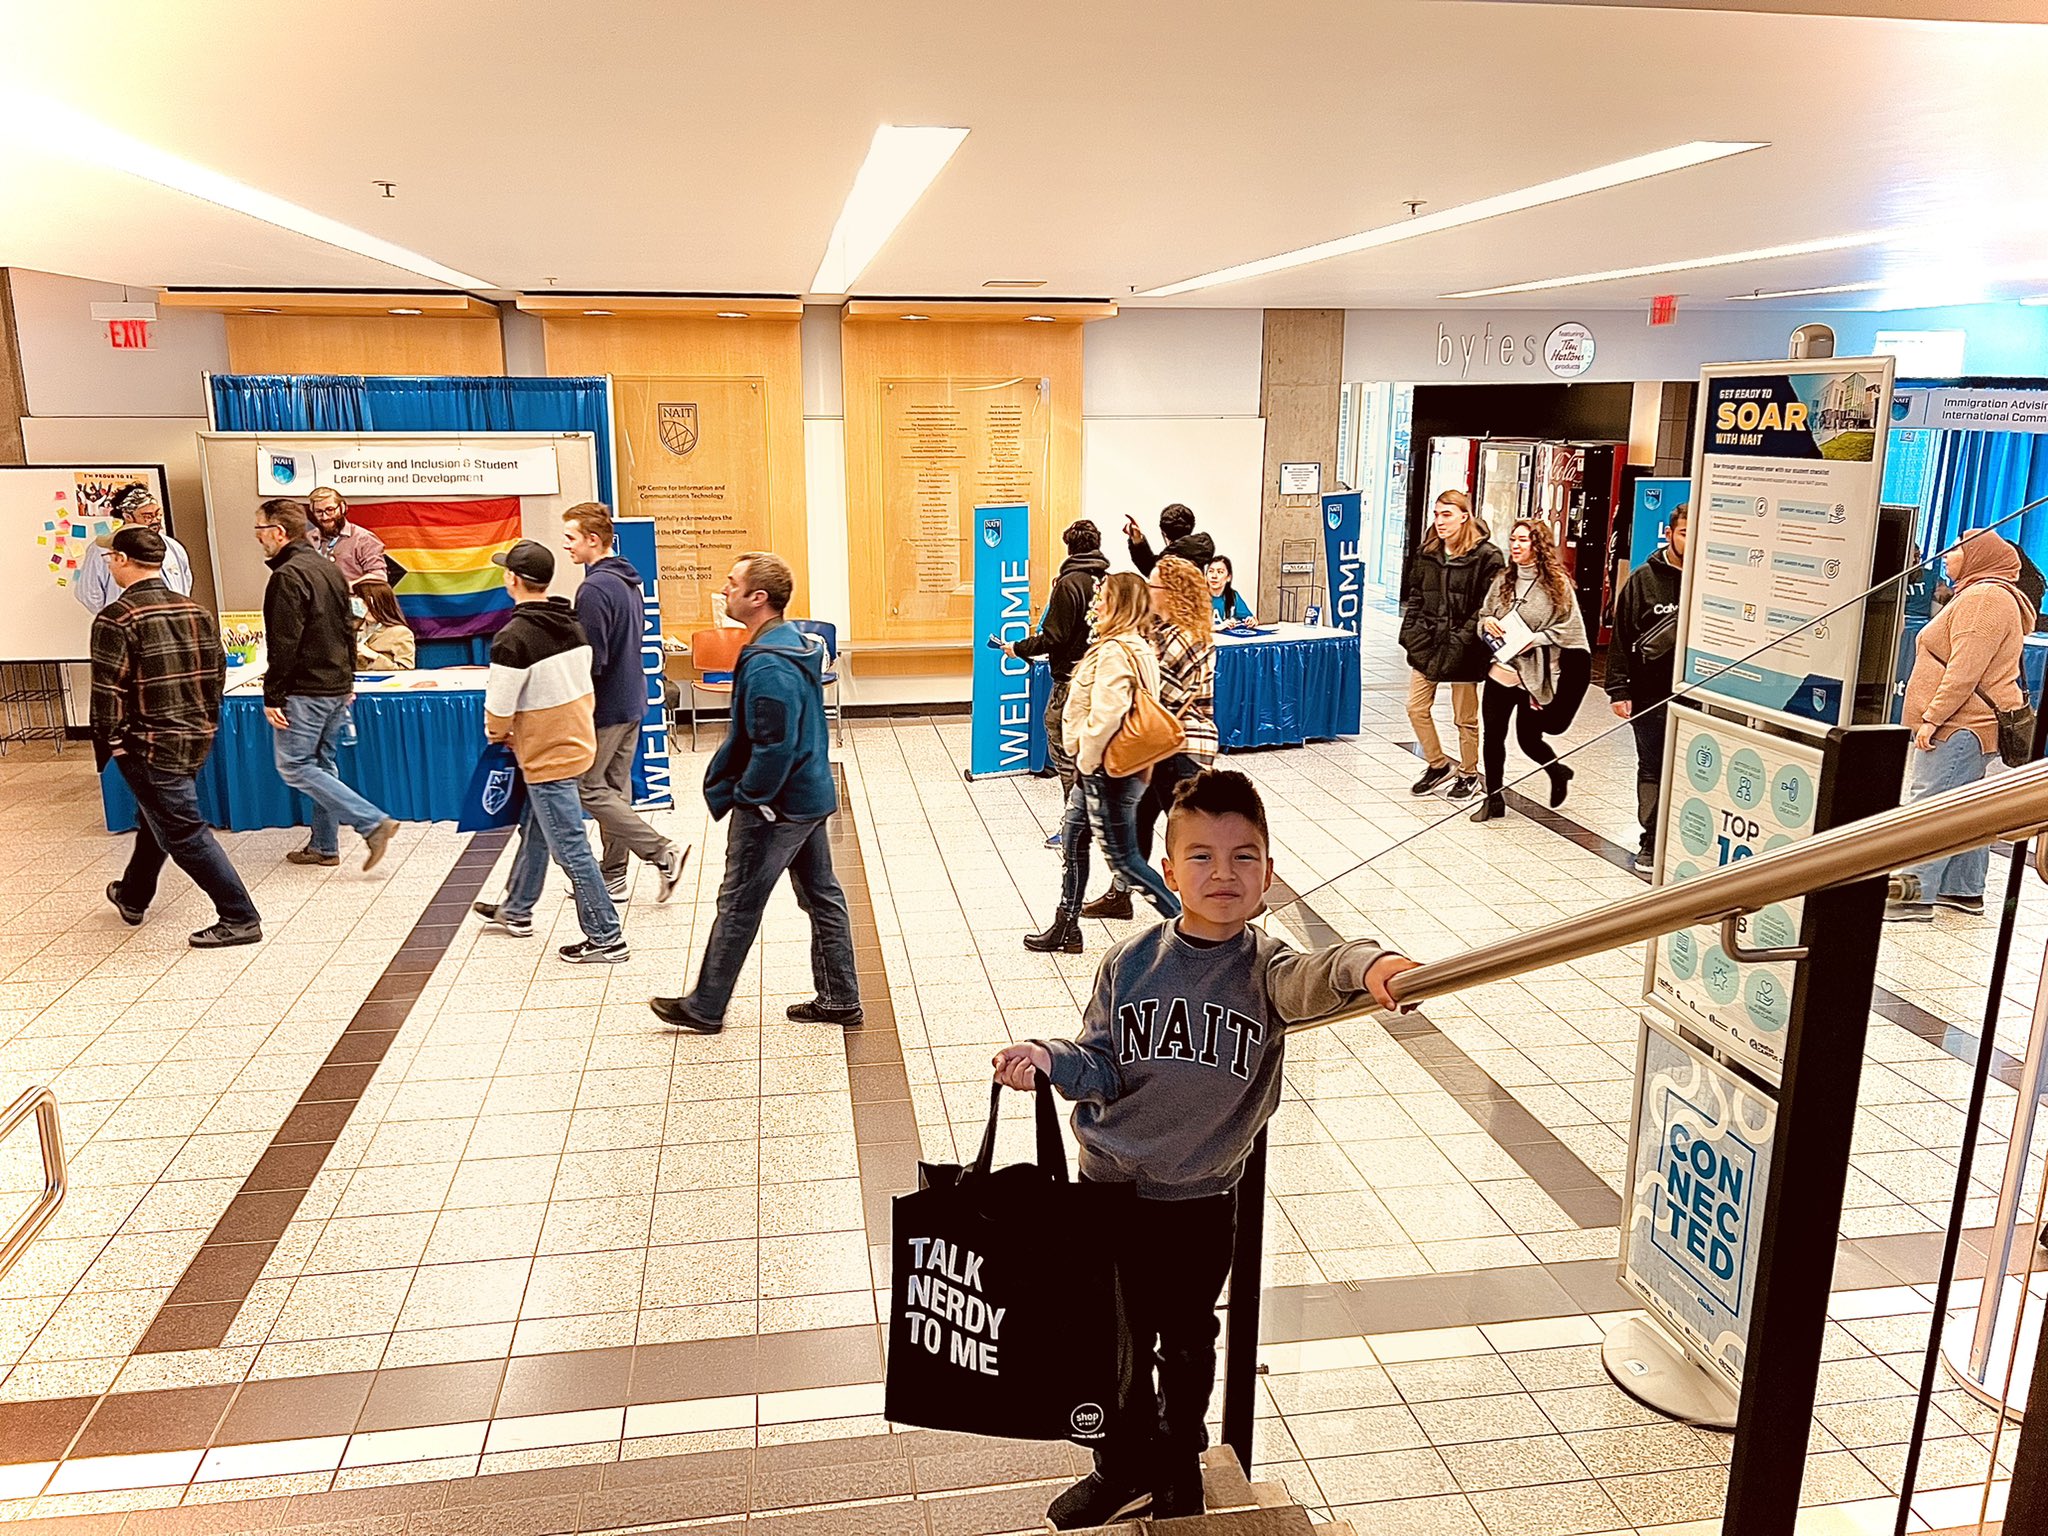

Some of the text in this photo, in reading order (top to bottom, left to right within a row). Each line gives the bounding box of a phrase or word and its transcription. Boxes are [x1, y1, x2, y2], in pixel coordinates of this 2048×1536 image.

[109, 320, 147, 347] EXIT
[1561, 339, 1578, 350] Tim
[1437, 322, 1537, 378] bytes
[1551, 350, 1584, 361] Hortons
[1719, 389, 1772, 399] GET READY TO
[1944, 398, 2008, 410] Immigration
[663, 407, 693, 418] NAIT
[1716, 402, 1808, 431] SOAR
[1942, 411, 2047, 423] International Comm
[1715, 433, 1763, 446] WITH NAIT
[273, 456, 293, 465] NAIT
[333, 459, 383, 470] Diversity
[386, 459, 408, 469] and
[410, 459, 461, 469] Inclusion
[474, 459, 518, 469] Student
[333, 473, 484, 486] Learning and Development
[1000, 560, 1031, 766] WELCOME
[641, 578, 672, 806] WELCOME
[1721, 809, 1760, 842] TOP
[1118, 997, 1264, 1081] NAIT
[1670, 1123, 1744, 1206] CON
[1667, 1159, 1740, 1244] NEC
[1667, 1197, 1734, 1281] TED
[908, 1237, 984, 1293] TALK
[907, 1274, 1006, 1340] NERDY
[905, 1311, 999, 1376] TO ME
[1076, 1412, 1099, 1422] shop
